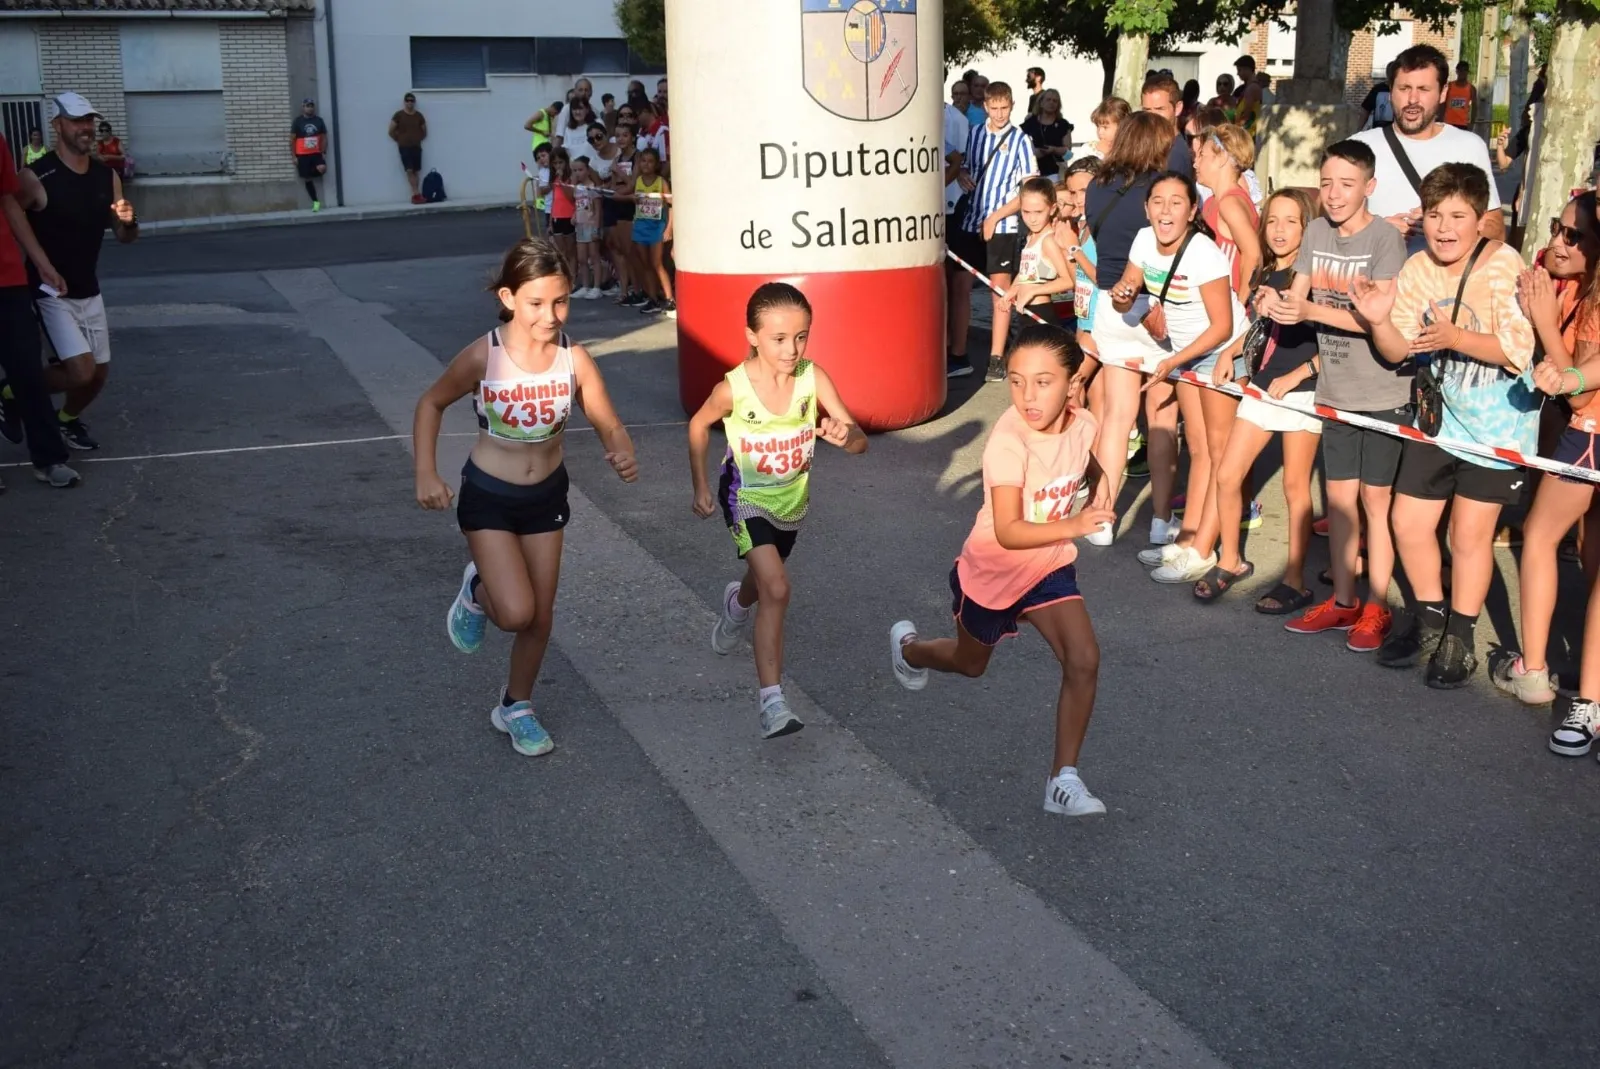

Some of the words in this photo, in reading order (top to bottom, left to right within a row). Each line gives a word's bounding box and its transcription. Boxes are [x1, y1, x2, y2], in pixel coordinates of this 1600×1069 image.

[759, 135, 939, 188] Diputación
[740, 220, 773, 249] de
[483, 379, 570, 403] bedunia
[501, 399, 556, 428] 435
[740, 428, 813, 454] bedunia
[756, 448, 803, 476] 438
